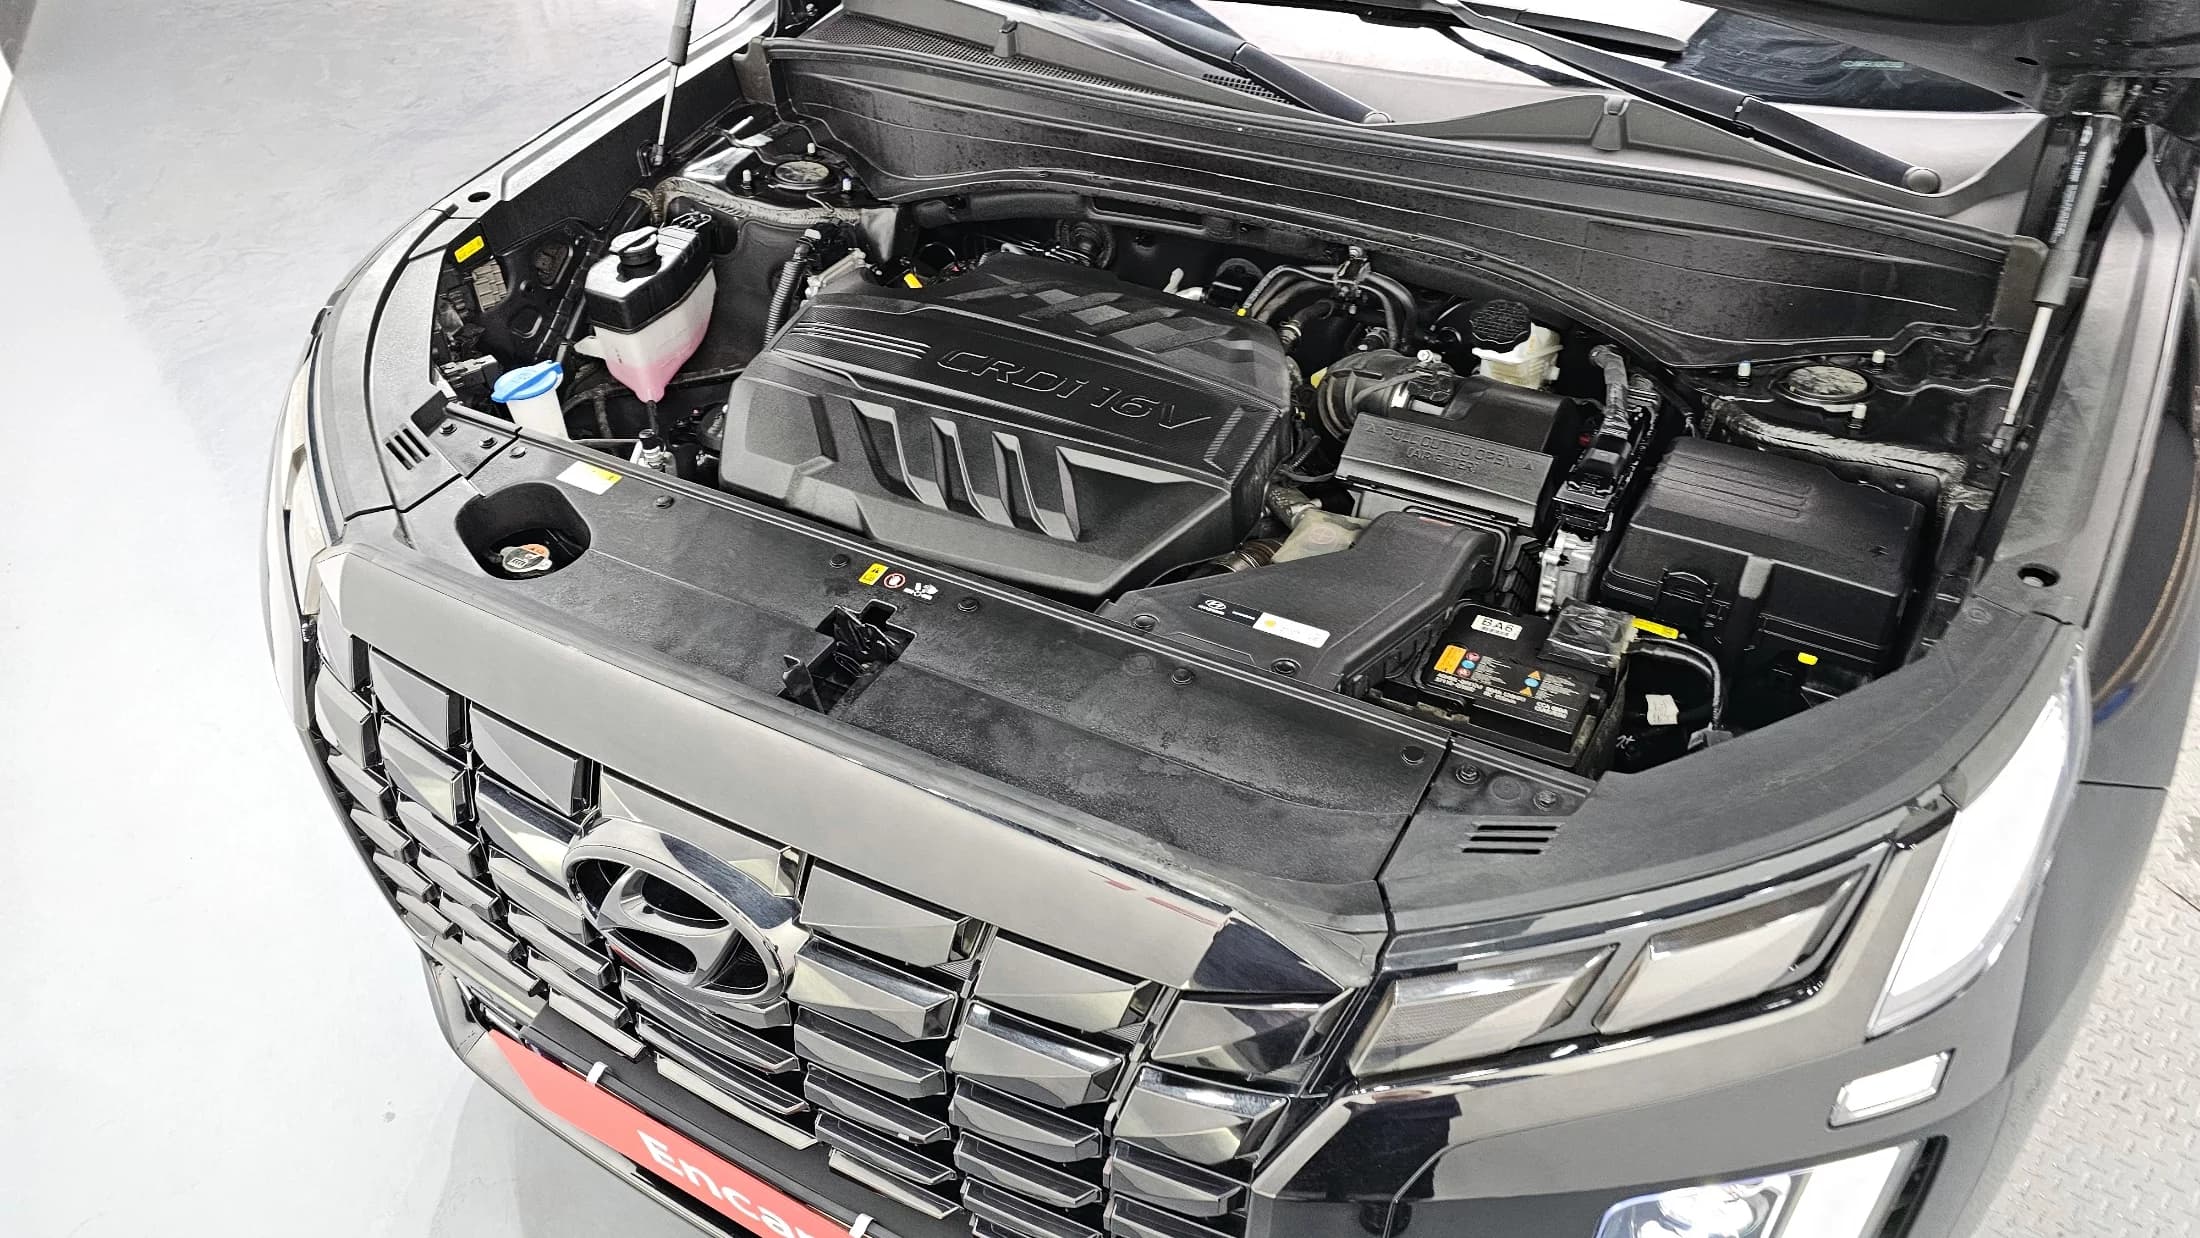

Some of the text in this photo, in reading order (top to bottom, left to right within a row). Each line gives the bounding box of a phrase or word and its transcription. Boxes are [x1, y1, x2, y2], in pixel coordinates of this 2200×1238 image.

[1090, 385, 1212, 430] 16V
[1384, 426, 1513, 468] PULL OUT TO OPEN
